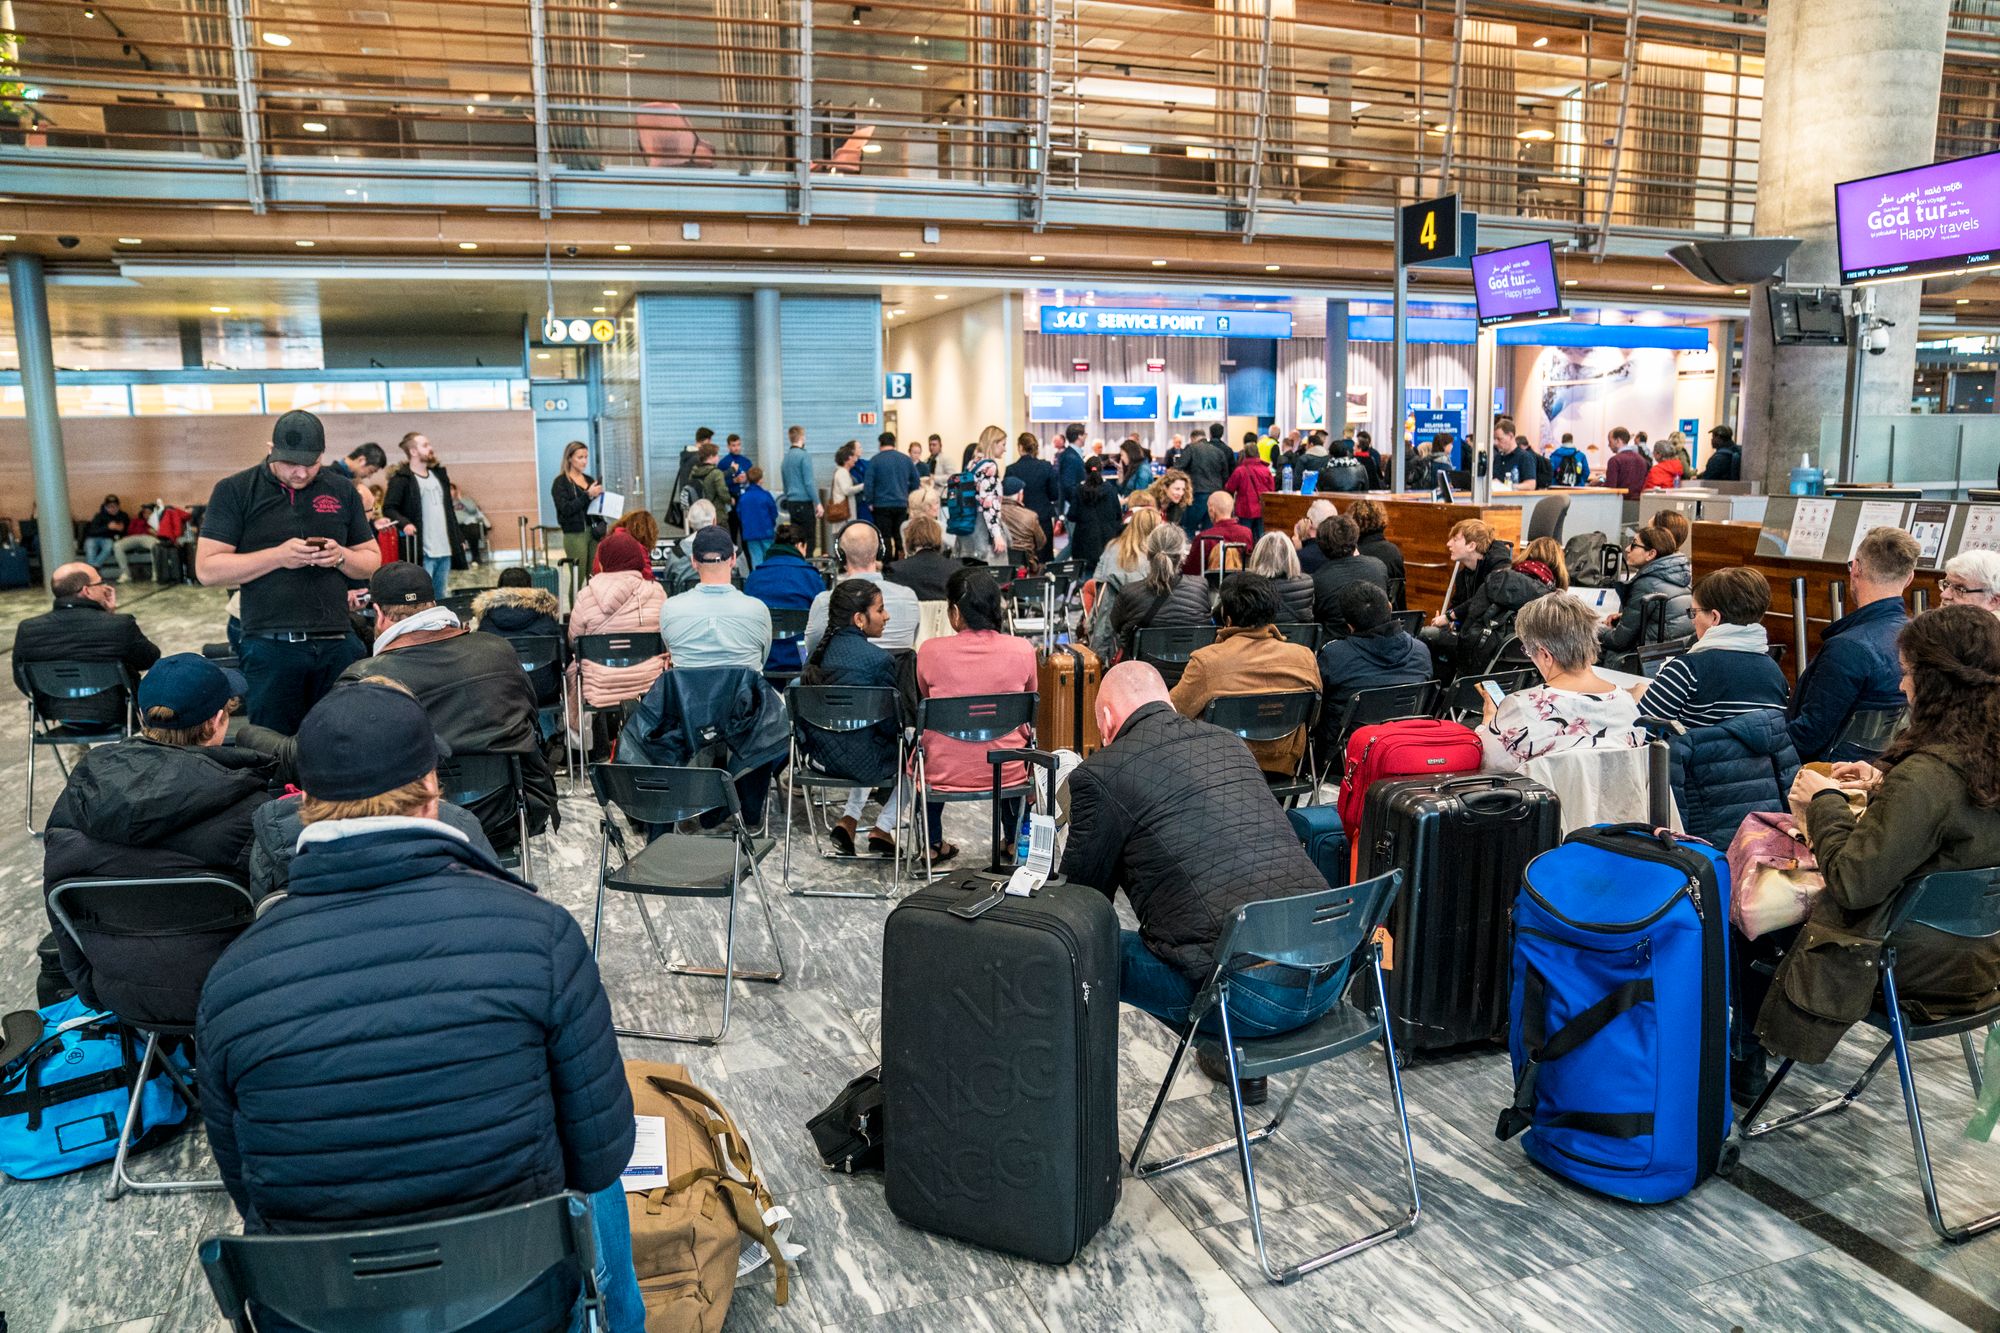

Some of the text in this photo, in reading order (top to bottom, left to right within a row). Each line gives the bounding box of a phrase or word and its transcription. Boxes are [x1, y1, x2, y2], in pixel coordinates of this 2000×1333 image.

[1927, 196, 1947, 205] voyage
[1868, 204, 1948, 230] God tur
[1420, 210, 1437, 250] 4
[1900, 226, 1938, 241] Happy
[1940, 217, 1980, 234] travels
[1488, 272, 1525, 290] God tur
[1504, 287, 1522, 300] Happy
[1522, 285, 1542, 296] travels
[1053, 312, 1205, 330] SAS SERVICE POINT
[891, 374, 907, 398] B
